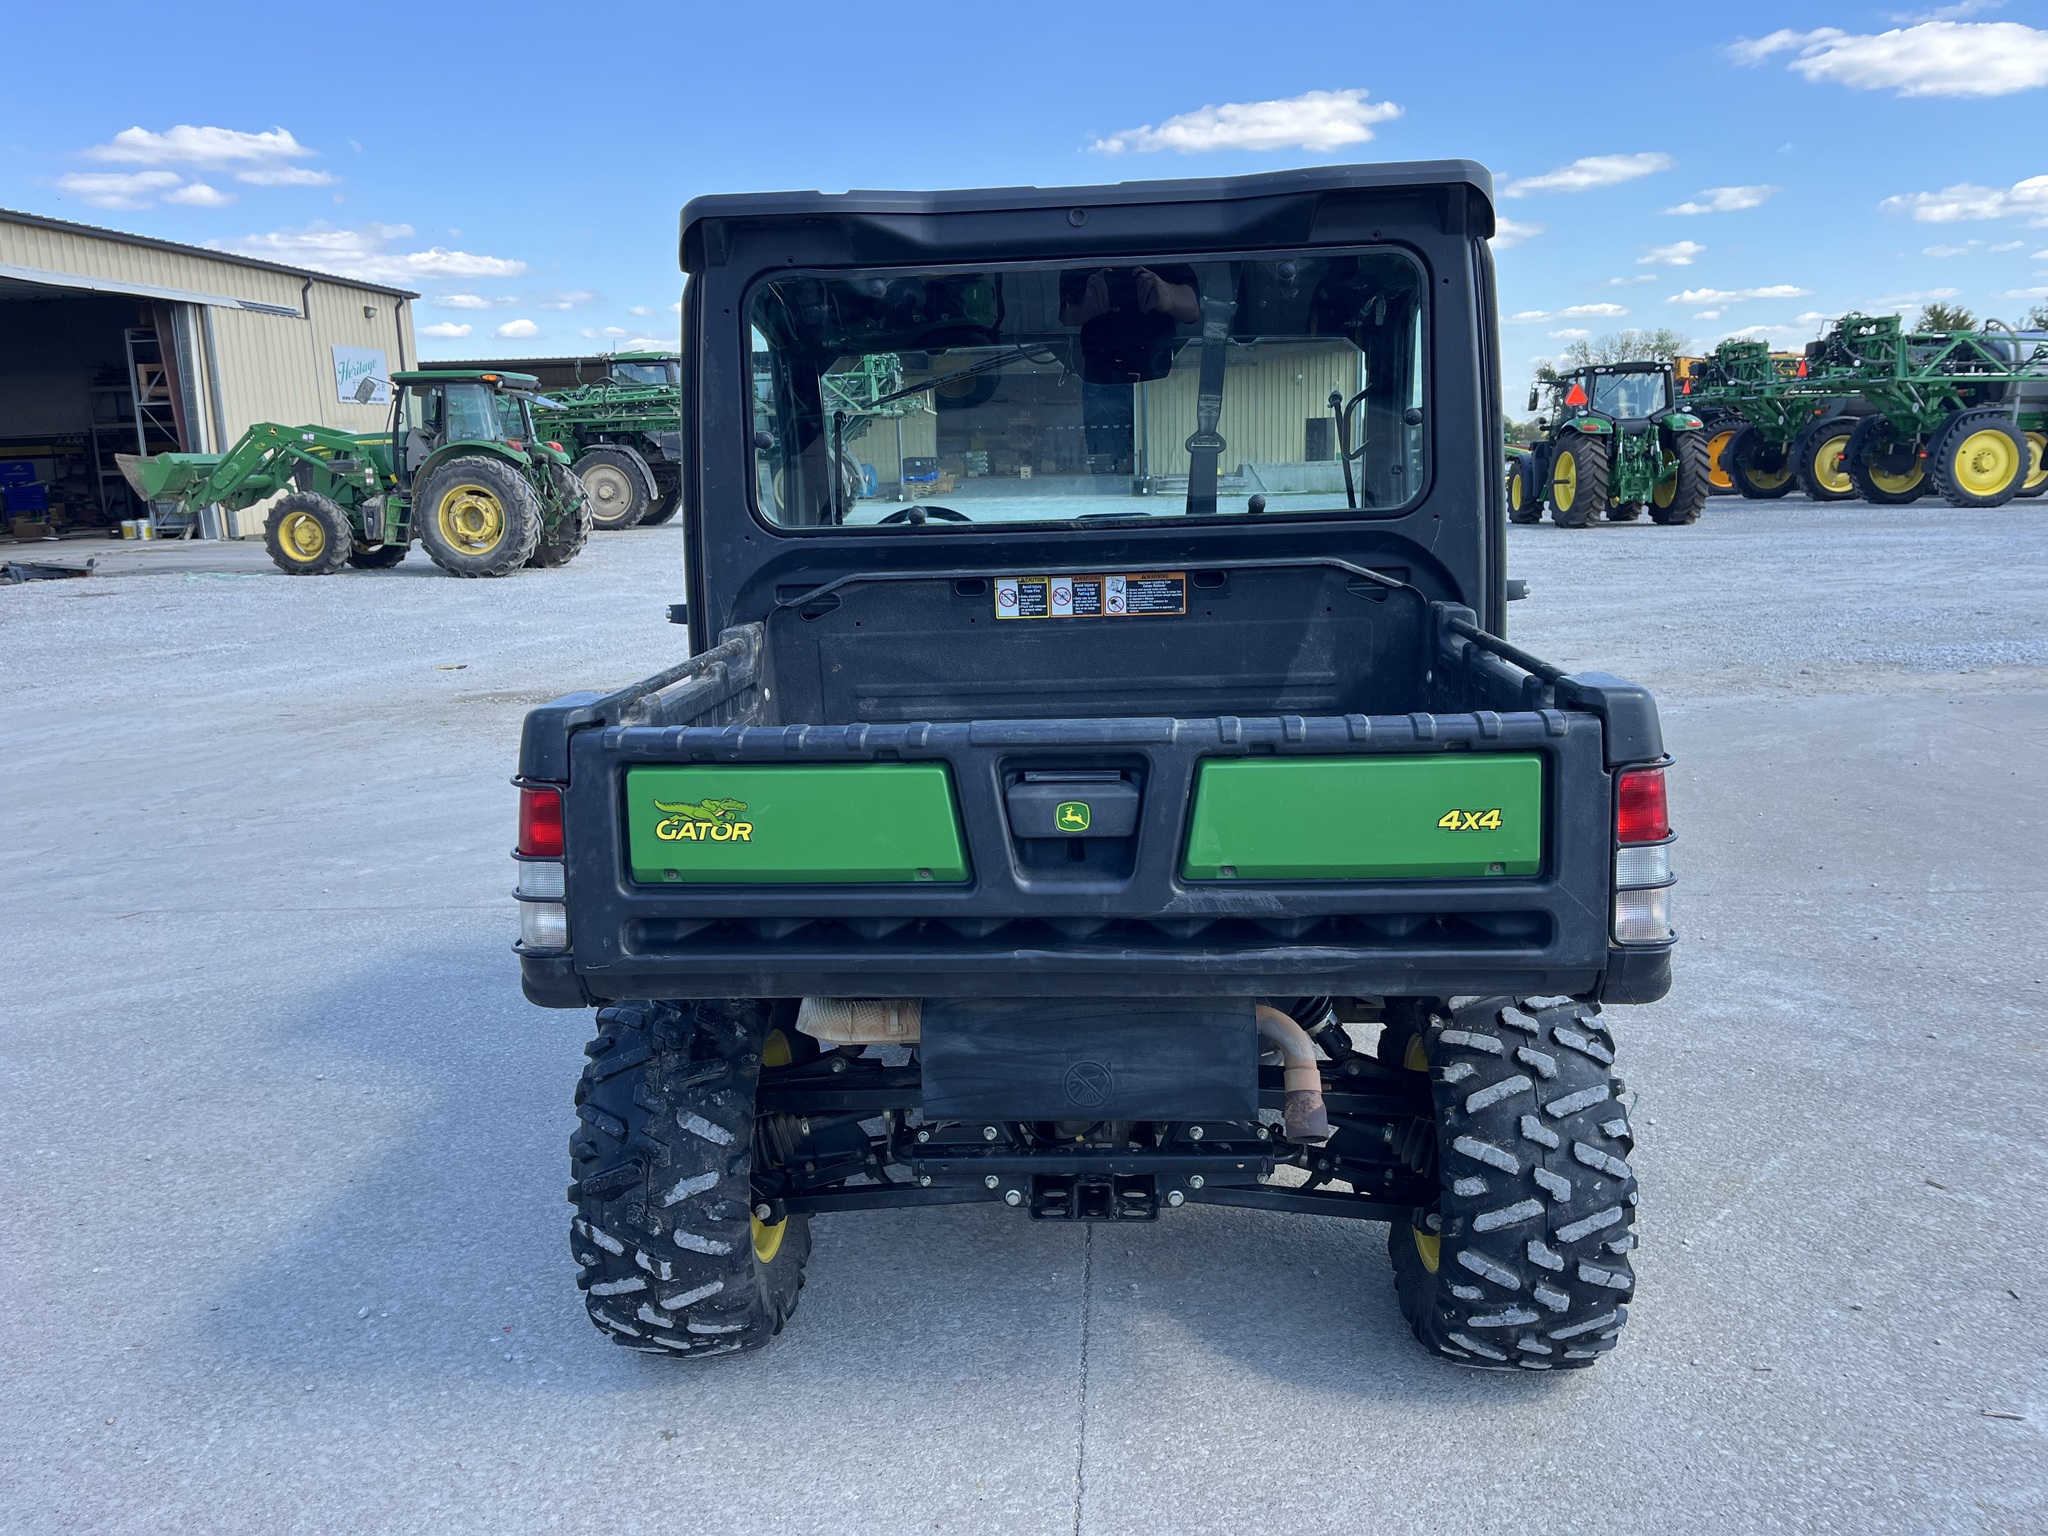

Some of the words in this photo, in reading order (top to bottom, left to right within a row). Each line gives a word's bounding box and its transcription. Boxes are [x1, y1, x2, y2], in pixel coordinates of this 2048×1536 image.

[337, 357, 377, 385] Heritage
[655, 818, 754, 842] GATOR
[1437, 808, 1503, 831] 4x4
